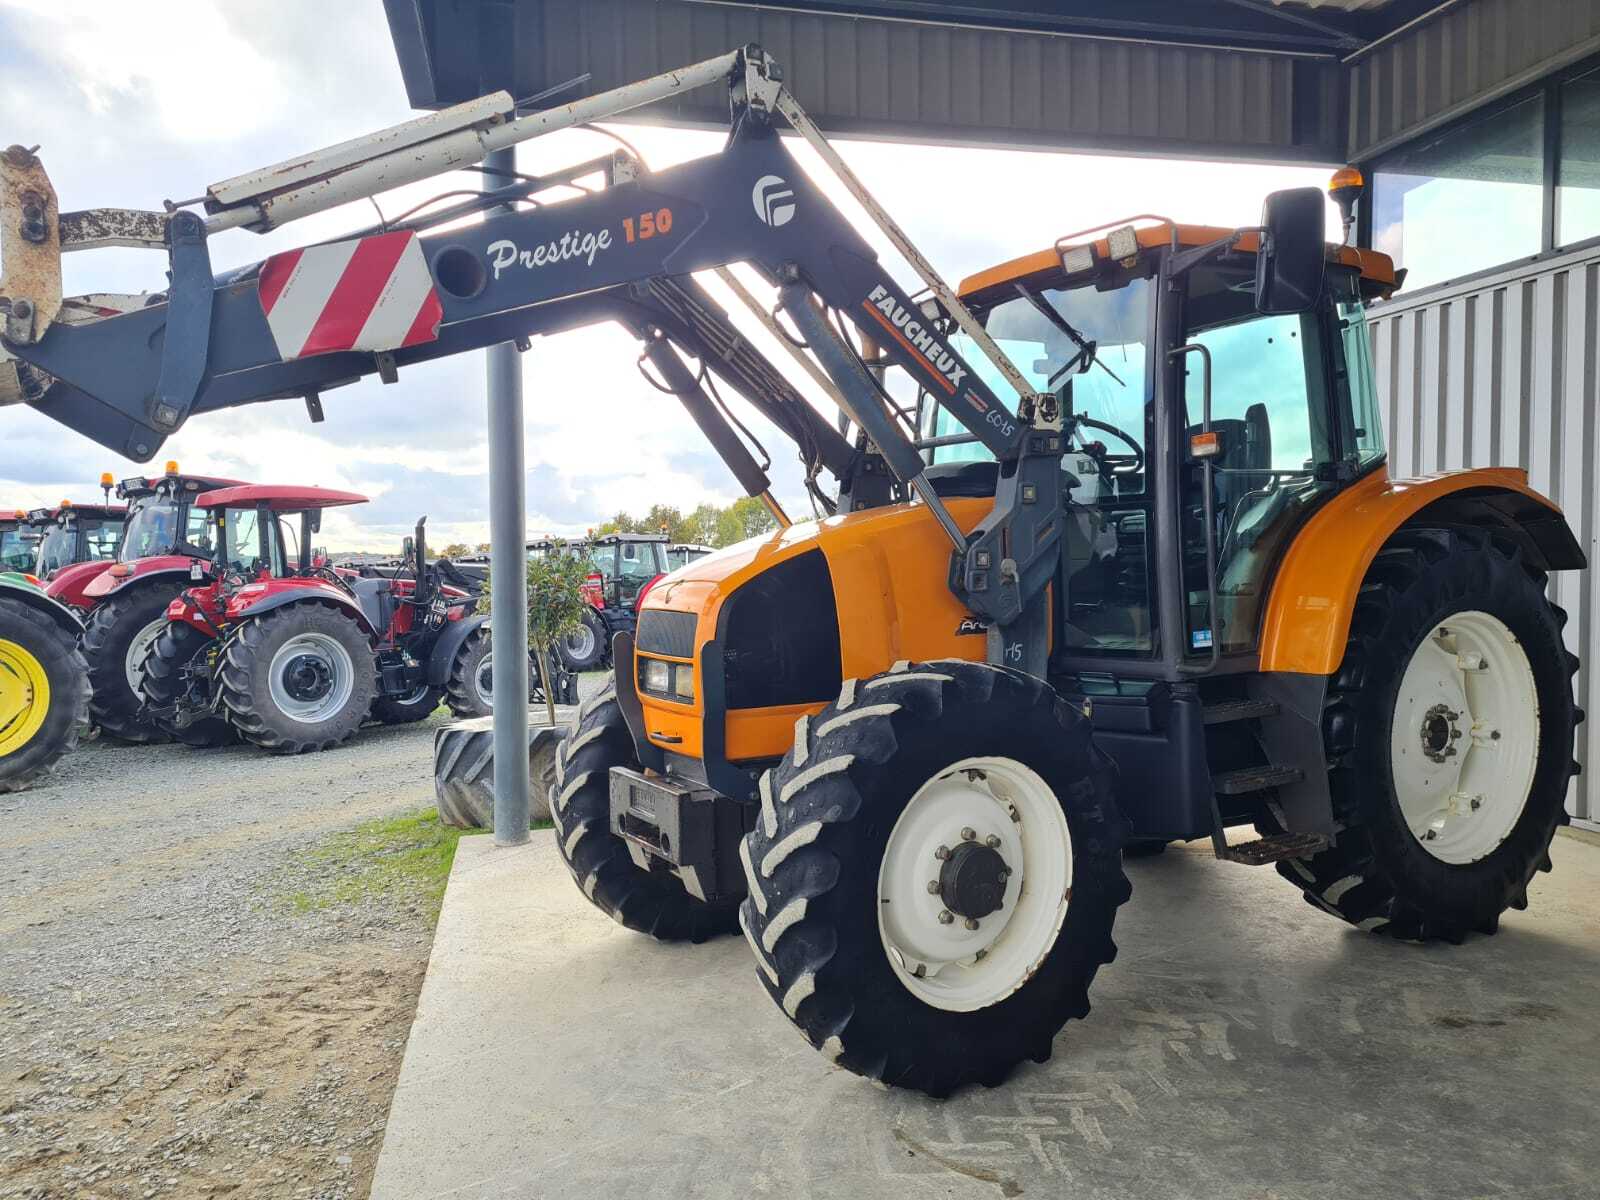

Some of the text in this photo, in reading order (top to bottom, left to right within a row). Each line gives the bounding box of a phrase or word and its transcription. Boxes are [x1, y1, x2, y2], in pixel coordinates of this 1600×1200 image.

[486, 208, 673, 280] Prestige 150
[868, 284, 968, 387] FAUCHEUX
